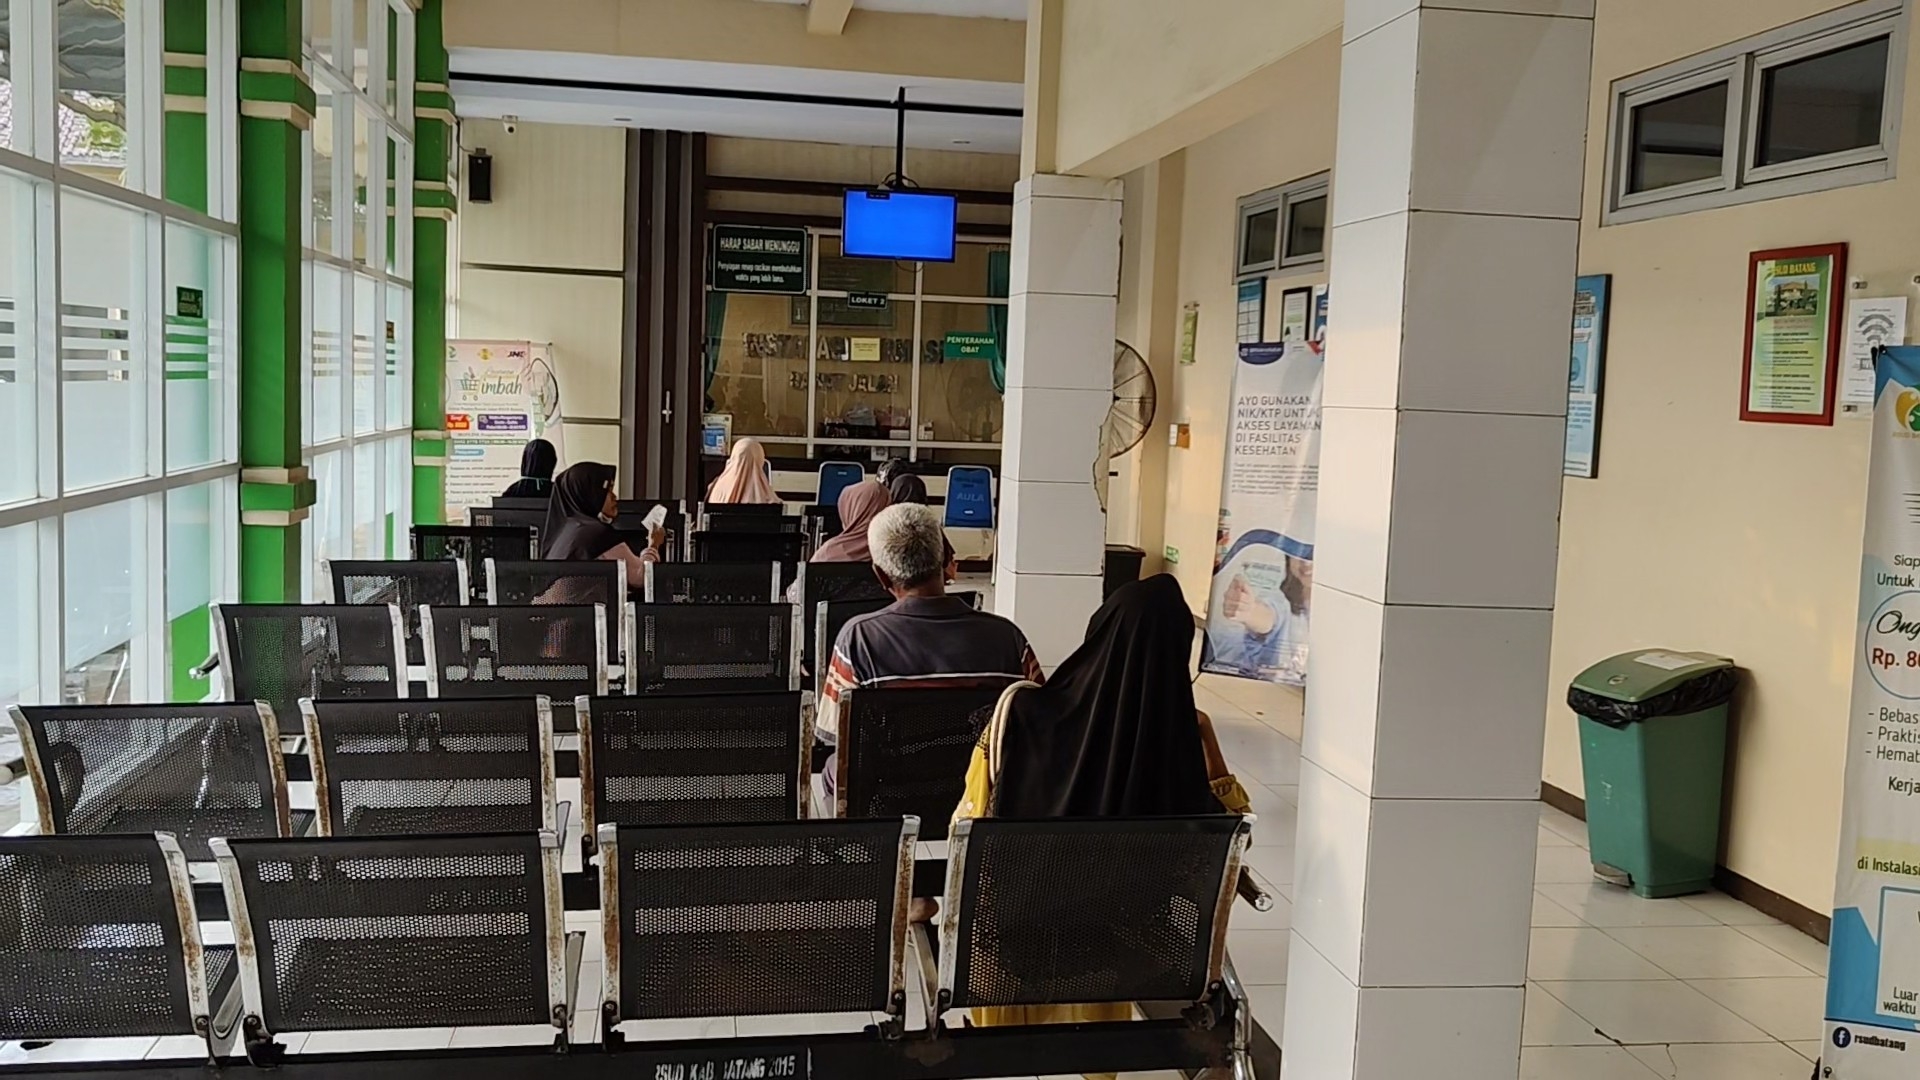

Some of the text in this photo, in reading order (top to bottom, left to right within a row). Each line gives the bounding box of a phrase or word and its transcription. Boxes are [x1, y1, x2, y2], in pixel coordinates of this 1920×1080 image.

[720, 237, 801, 252] HARAP SABAR MENUNGGU
[851, 296, 878, 305] LOKET
[946, 336, 995, 344] PENYERAHAN
[1237, 395, 1259, 406] AYO
[1237, 407, 1282, 419] NIK/KTP
[1236, 420, 1271, 431] AKSES
[1235, 432, 1302, 443] DI FASILITAS
[1234, 445, 1297, 456] KESEHATAN
[956, 492, 985, 502] AULA
[1877, 572, 1915, 588] Untuk
[1872, 647, 1920, 670] Rp. 8
[1879, 706, 1919, 724] Bebas
[1876, 745, 1920, 763] Hemat
[1857, 856, 1869, 870] di
[1893, 986, 1919, 1001] Luar
[1883, 1000, 1916, 1015] waktu
[1854, 1034, 1906, 1052] rsudbatang
[768, 1055, 796, 1077] 2015
